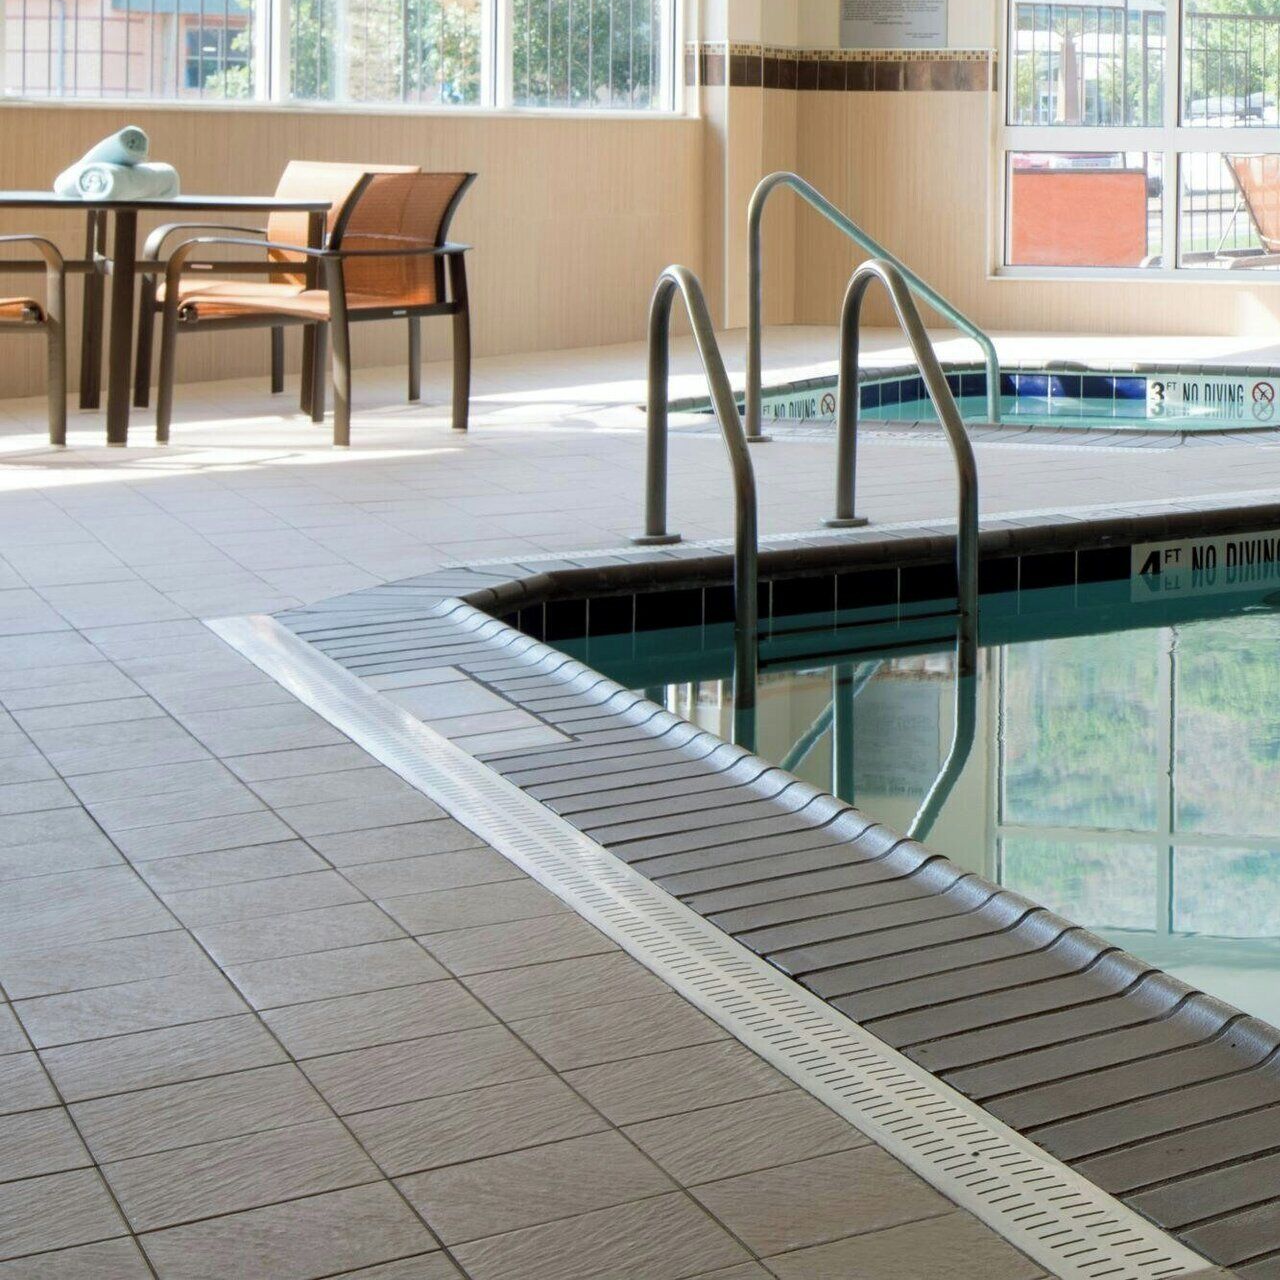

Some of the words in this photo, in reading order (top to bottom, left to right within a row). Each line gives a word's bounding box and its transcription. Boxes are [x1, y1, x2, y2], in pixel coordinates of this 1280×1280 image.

[1183, 382, 1198, 402] NO
[1204, 383, 1244, 402] DIVING
[1192, 545, 1217, 570] NO
